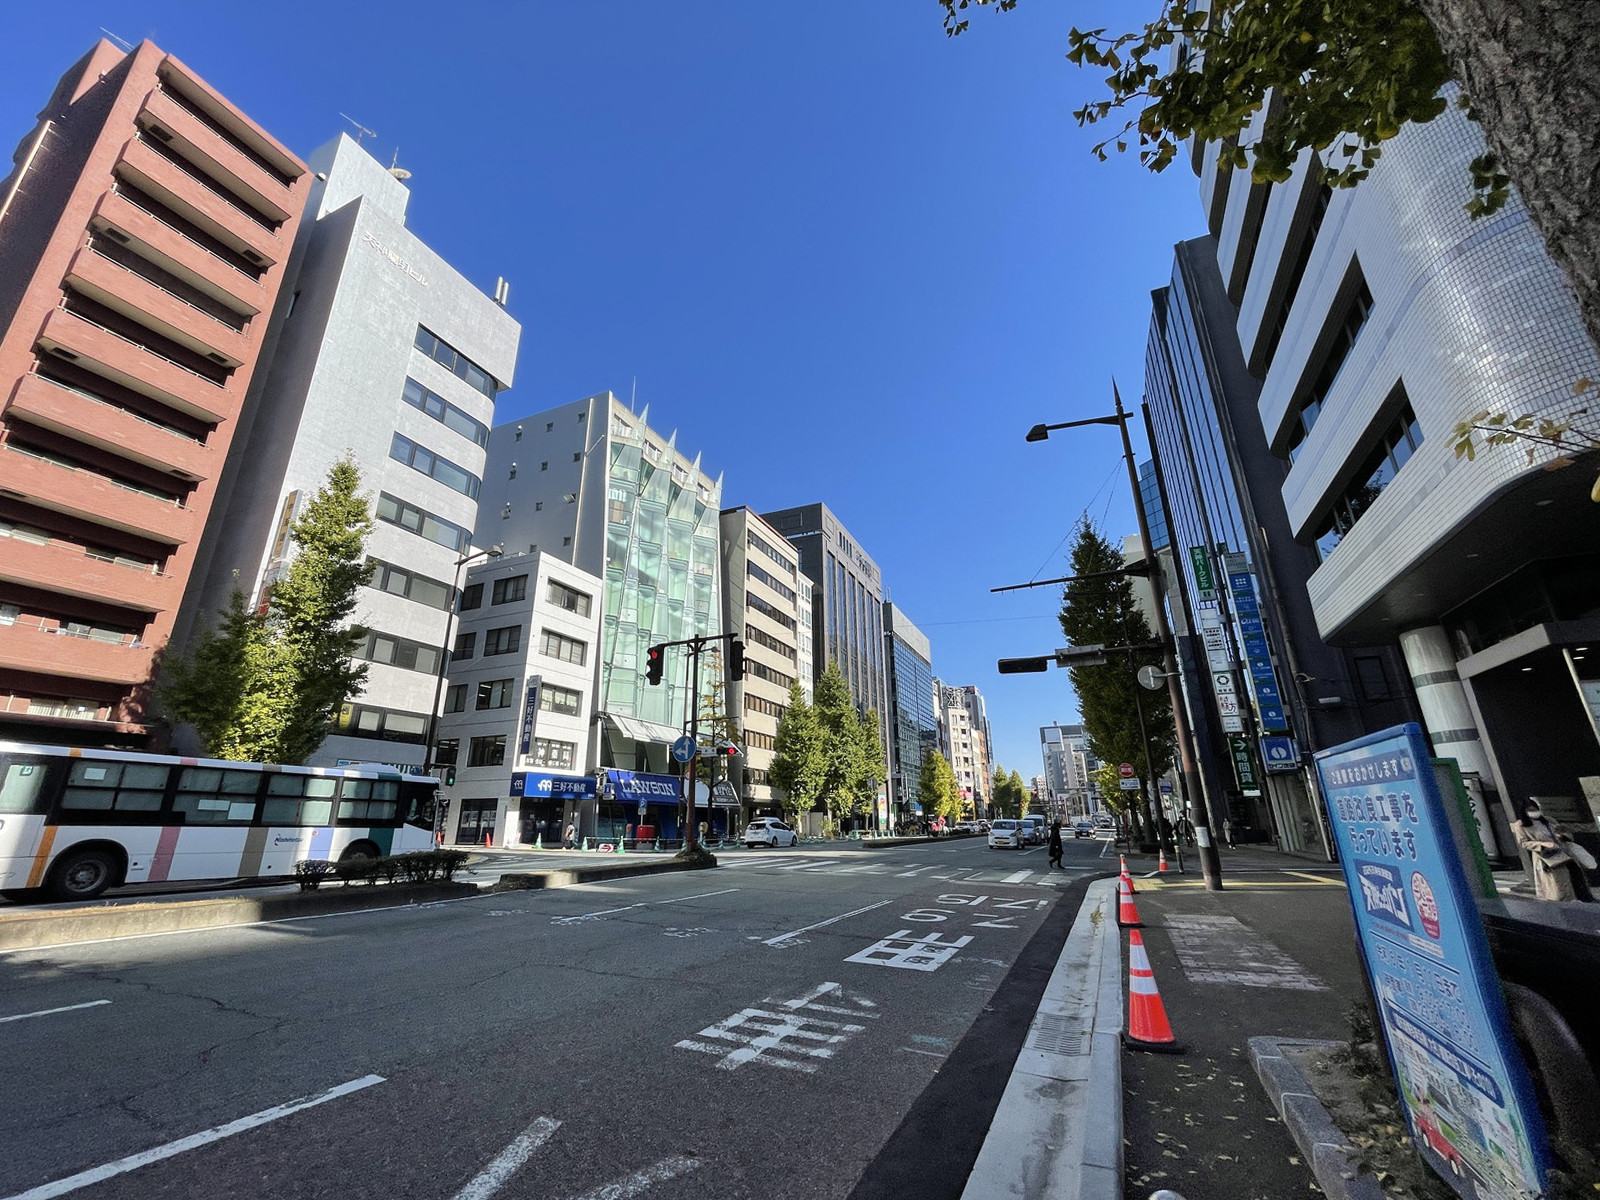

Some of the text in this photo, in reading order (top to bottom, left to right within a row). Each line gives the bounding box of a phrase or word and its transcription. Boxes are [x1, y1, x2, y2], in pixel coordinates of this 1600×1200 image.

[522, 696, 535, 742] 三好不動産
[552, 781, 586, 793] 三好不動産
[620, 779, 676, 797] LAWSON
